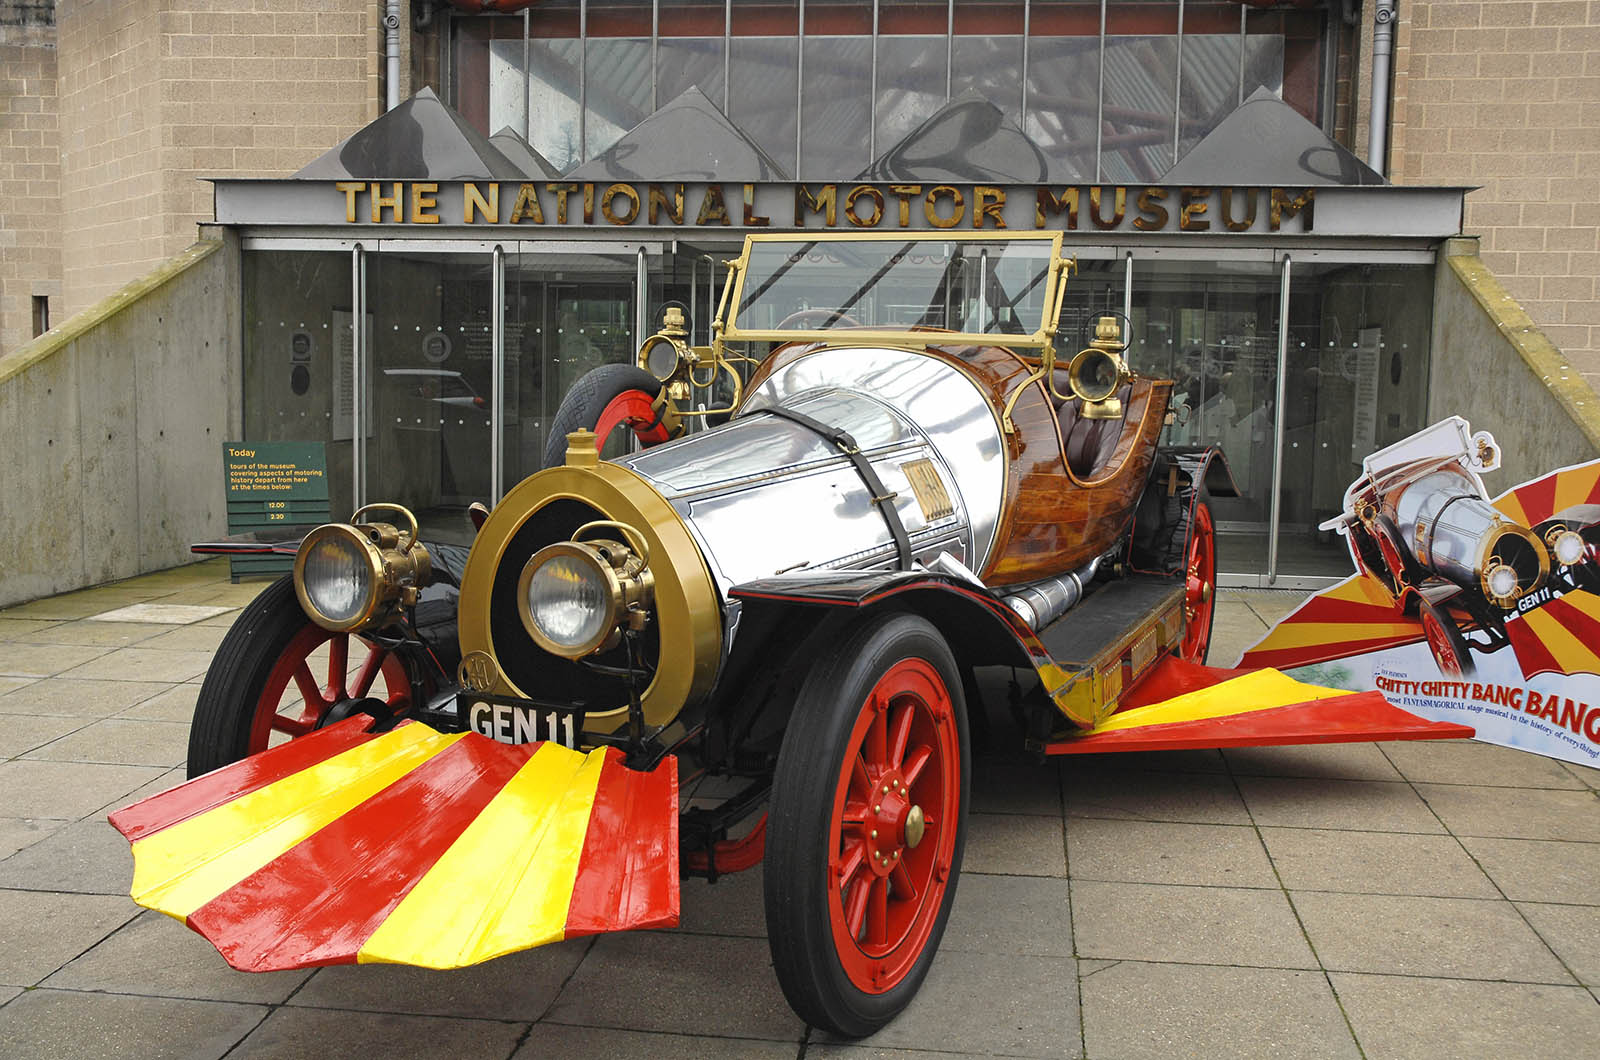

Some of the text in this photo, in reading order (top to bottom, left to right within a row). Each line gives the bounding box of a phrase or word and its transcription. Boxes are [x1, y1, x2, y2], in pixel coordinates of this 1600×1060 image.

[335, 182, 1317, 232] THE NATIONAL MOTOR MUSEUM
[229, 449, 255, 458] Today
[1518, 587, 1550, 611] GEN 11
[470, 702, 574, 750] GEN 11
[1376, 676, 1600, 745] CHITTY CHITTY BANG BANG
[1404, 698, 1465, 709] FANTASMAGORICAL
[1467, 704, 1483, 713] stage
[1485, 708, 1508, 718] musical
[1519, 716, 1529, 724] the
[1530, 720, 1552, 736] history
[1562, 733, 1600, 758] everything!
